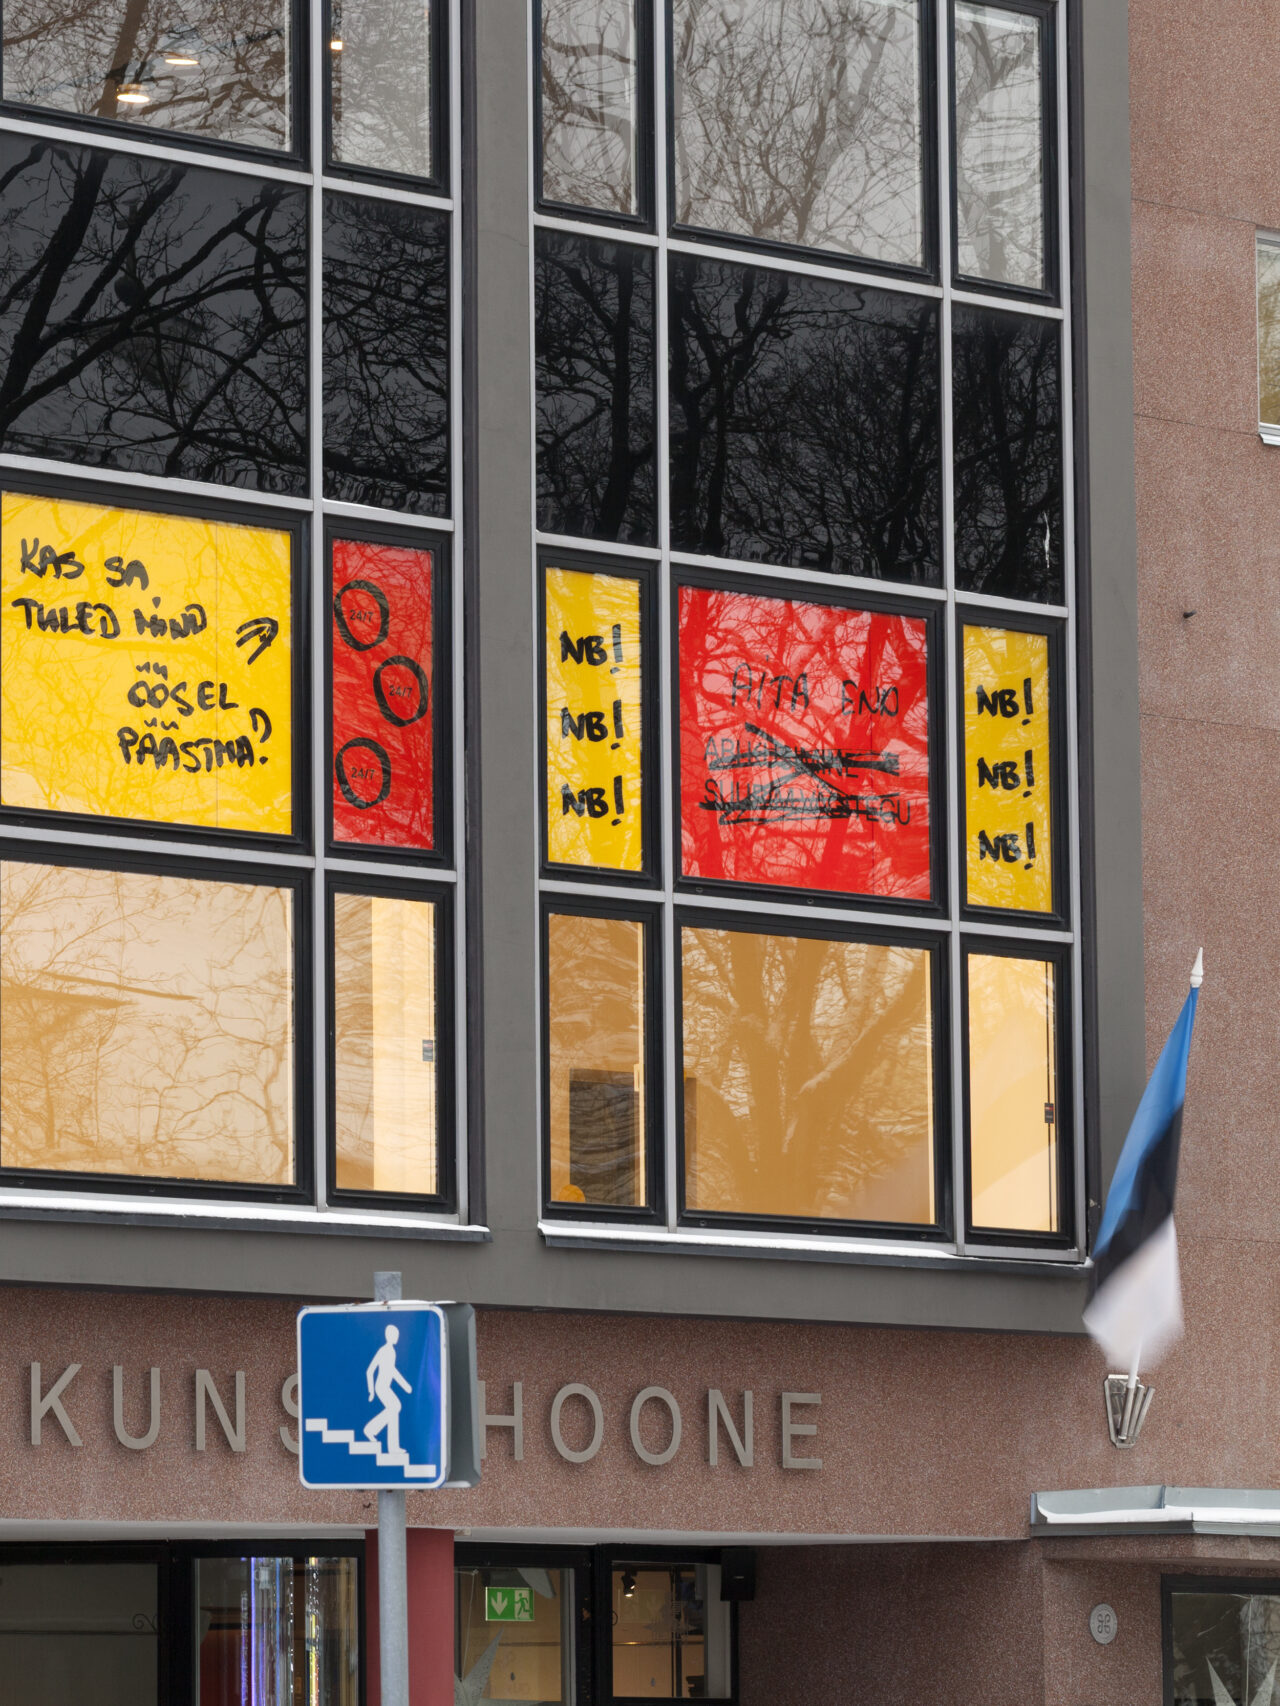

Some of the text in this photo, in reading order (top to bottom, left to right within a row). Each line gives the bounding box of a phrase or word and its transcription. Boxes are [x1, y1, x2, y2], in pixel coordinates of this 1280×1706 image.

[20, 538, 150, 590] KAS SA
[349, 608, 373, 624] 24/7
[560, 623, 624, 674] NB!
[388, 683, 412, 699] 24/7
[976, 677, 1033, 726] NB!
[560, 699, 624, 750] NB!
[350, 765, 374, 781] 24/7
[978, 750, 1035, 798] NB!
[561, 775, 625, 826] NB!
[979, 822, 1036, 870] NB!
[30, 1362, 824, 1471] KUNHOONE
